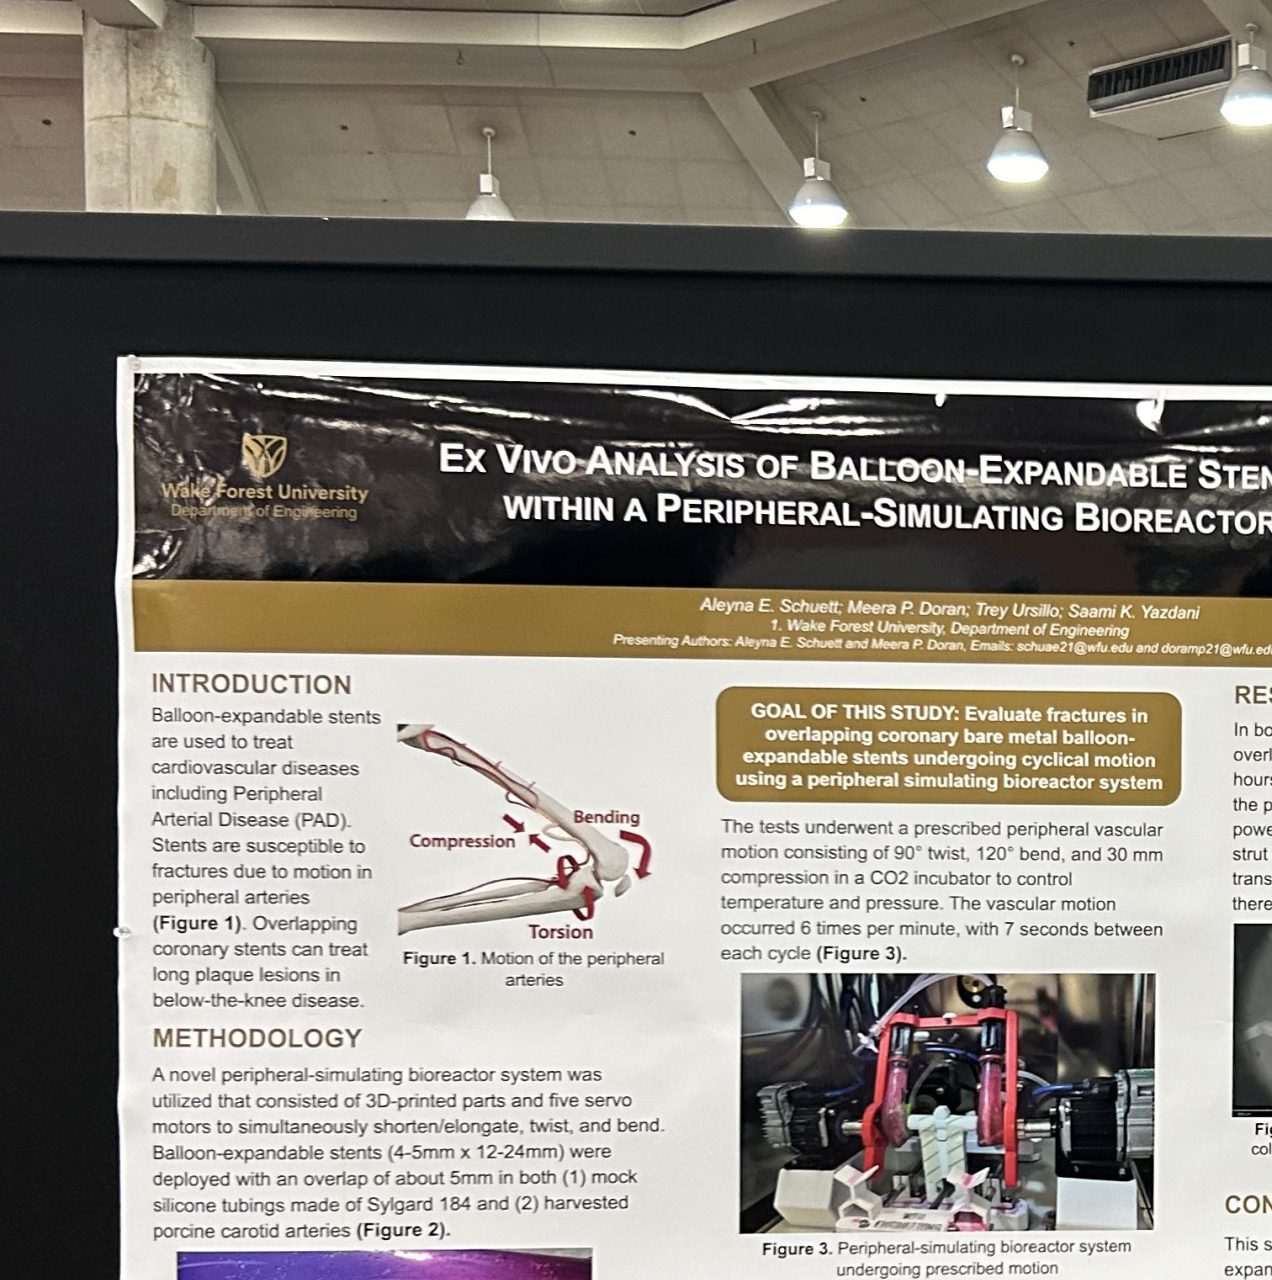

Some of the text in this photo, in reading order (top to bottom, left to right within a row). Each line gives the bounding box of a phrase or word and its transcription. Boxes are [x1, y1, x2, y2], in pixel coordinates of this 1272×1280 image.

[161, 483, 369, 504] Wake Forest University
[700, 598, 754, 615] Aleyna
[758, 599, 774, 613] E.
[848, 600, 897, 615] Meera
[901, 601, 914, 616] P.
[920, 601, 969, 618] Doran;
[975, 603, 1008, 620] Trey
[1068, 605, 1116, 619] Saami
[1120, 605, 1135, 619] K.
[1141, 605, 1200, 620] Yazdani
[613, 634, 679, 649] Presenting
[736, 636, 777, 650] Aleyna
[780, 637, 793, 648] E.
[796, 637, 843, 649] Schuett
[846, 638, 868, 649] and
[870, 638, 910, 650] Meera
[913, 639, 924, 651] P.
[927, 639, 966, 653] Doran,
[970, 641, 1014, 653] Emails:
[1016, 641, 1133, 656] schuae21@wfu.edu
[1136, 642, 1159, 654] and
[153, 673, 351, 694] INTRODUCTION
[152, 707, 381, 726] Balloon-expandable stents
[751, 703, 1147, 723] GOAL OF THIS STUDY: Evaluate fractures in
[152, 734, 293, 749] are used to treat
[152, 760, 359, 776] cardiovascular diseases
[574, 810, 640, 827] Bending
[410, 834, 515, 851] Compression
[528, 924, 593, 939] Torsion
[403, 951, 664, 968] Figure 1. Motion of the peripheral
[505, 974, 563, 986] arteries
[153, 1028, 362, 1048] METHODOLOGY
[1225, 1237, 1258, 1251] This
